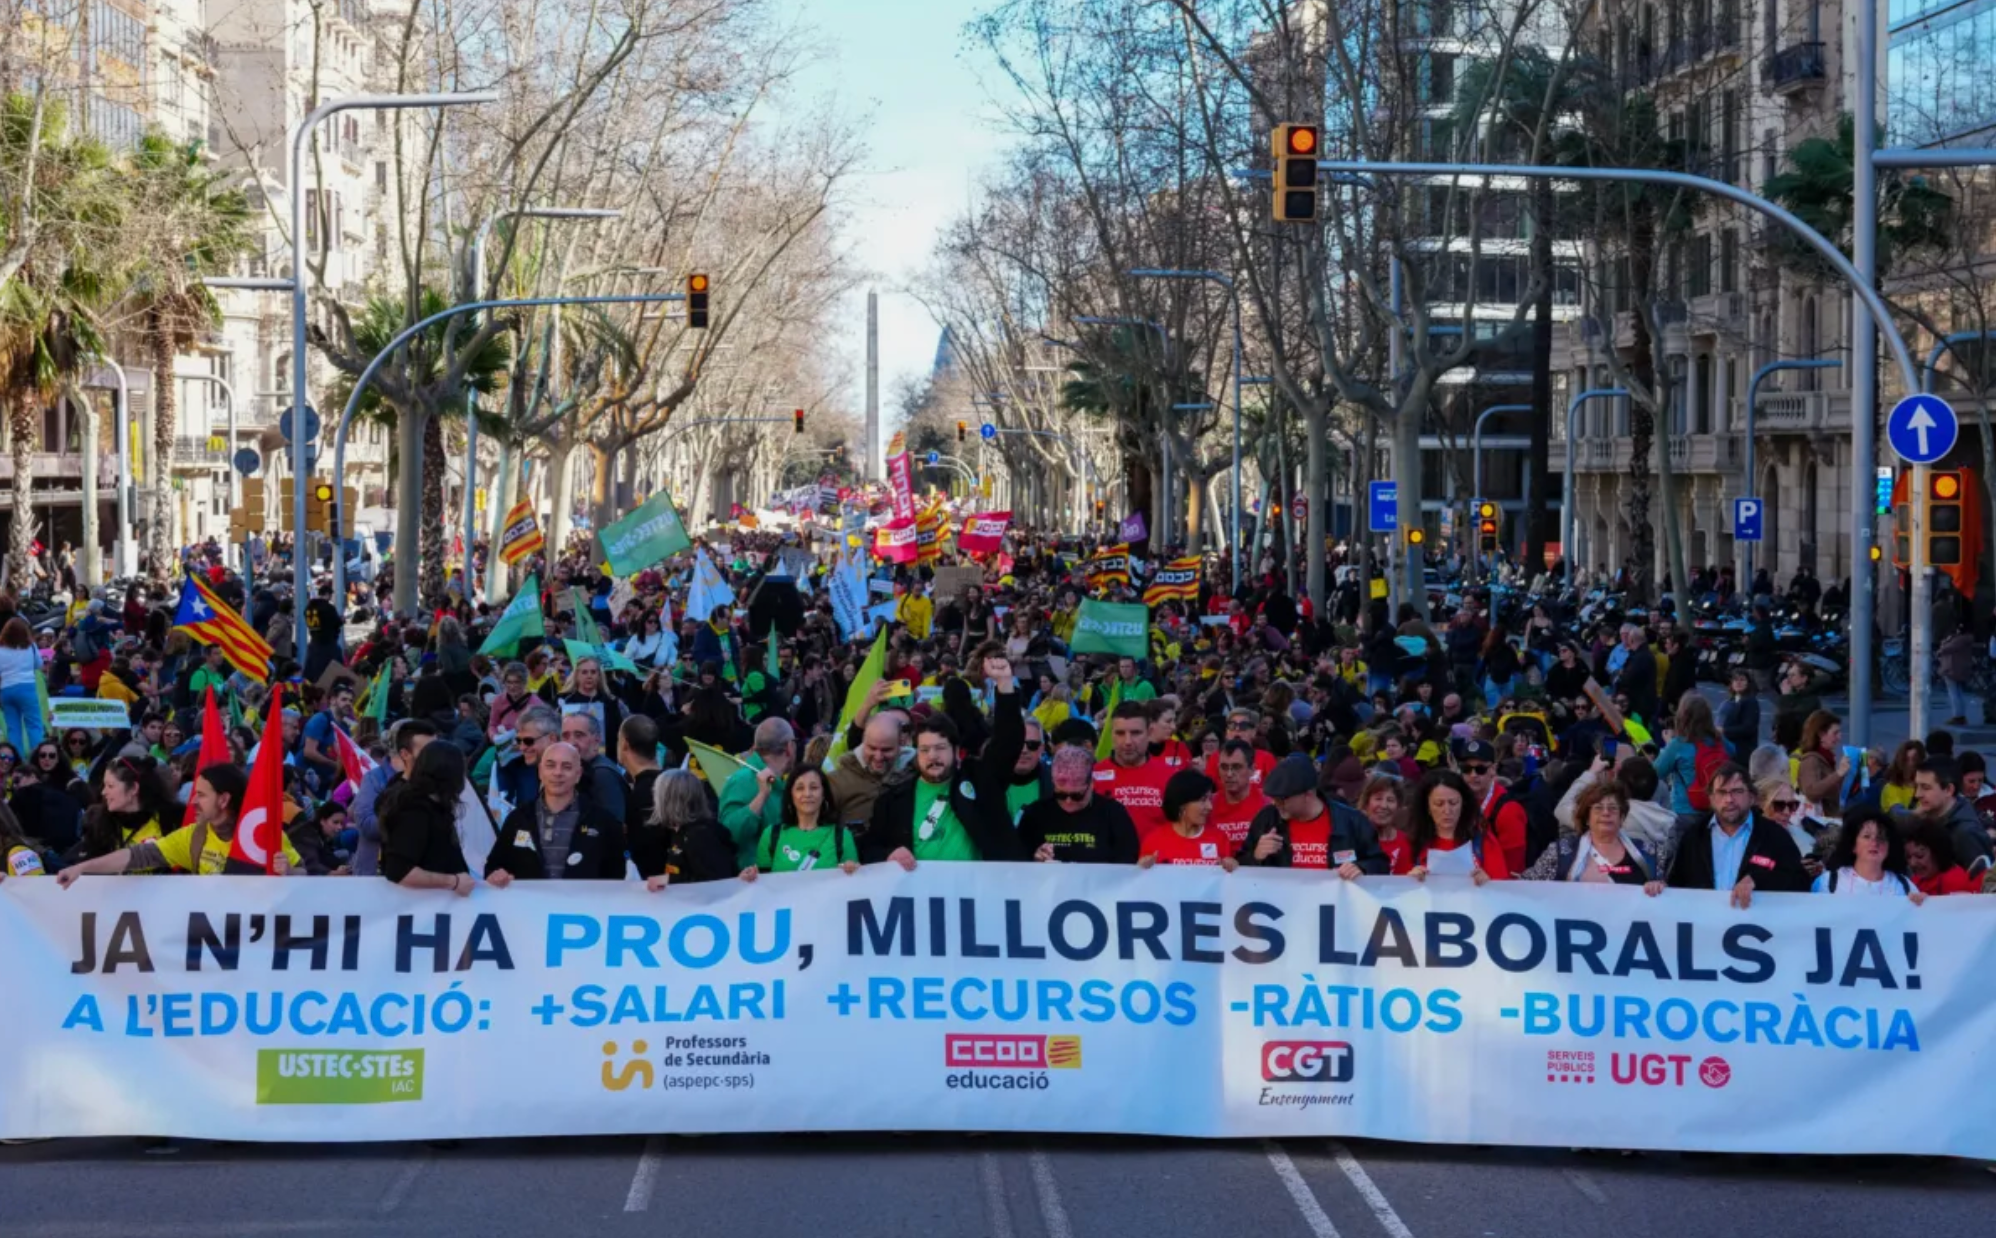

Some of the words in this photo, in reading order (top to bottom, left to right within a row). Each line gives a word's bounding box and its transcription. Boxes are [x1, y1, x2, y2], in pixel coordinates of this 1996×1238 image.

[1739, 501, 1757, 524] P
[1114, 786, 1160, 796] recursos
[1292, 853, 1327, 864] ducac
[71, 911, 155, 974] JA
[395, 913, 515, 973] HA
[545, 908, 814, 970] PROU,
[847, 896, 1286, 964] MILLORES
[1318, 904, 1776, 983] LABORALS
[1805, 926, 1923, 990] JA!
[61, 993, 105, 1032] A
[531, 979, 785, 1027] +SALARI
[827, 976, 1197, 1026] +RECURSOS
[1230, 973, 1463, 1033] -RÀTIOS
[1501, 992, 1921, 1052] -BUROCRÀCIA
[665, 1035, 747, 1050] Professors
[952, 1040, 1038, 1061] CCOO
[664, 1052, 683, 1067] de
[686, 1051, 771, 1066] Secundària
[1267, 1046, 1348, 1079] CGT
[1547, 1050, 1595, 1062] SERVEIS
[1547, 1060, 1595, 1073] PÚBLICS
[1610, 1053, 1692, 1087] UGT
[391, 1079, 415, 1094] IAC
[946, 1071, 1050, 1090] educació
[1258, 1087, 1354, 1110] Ensenyament
